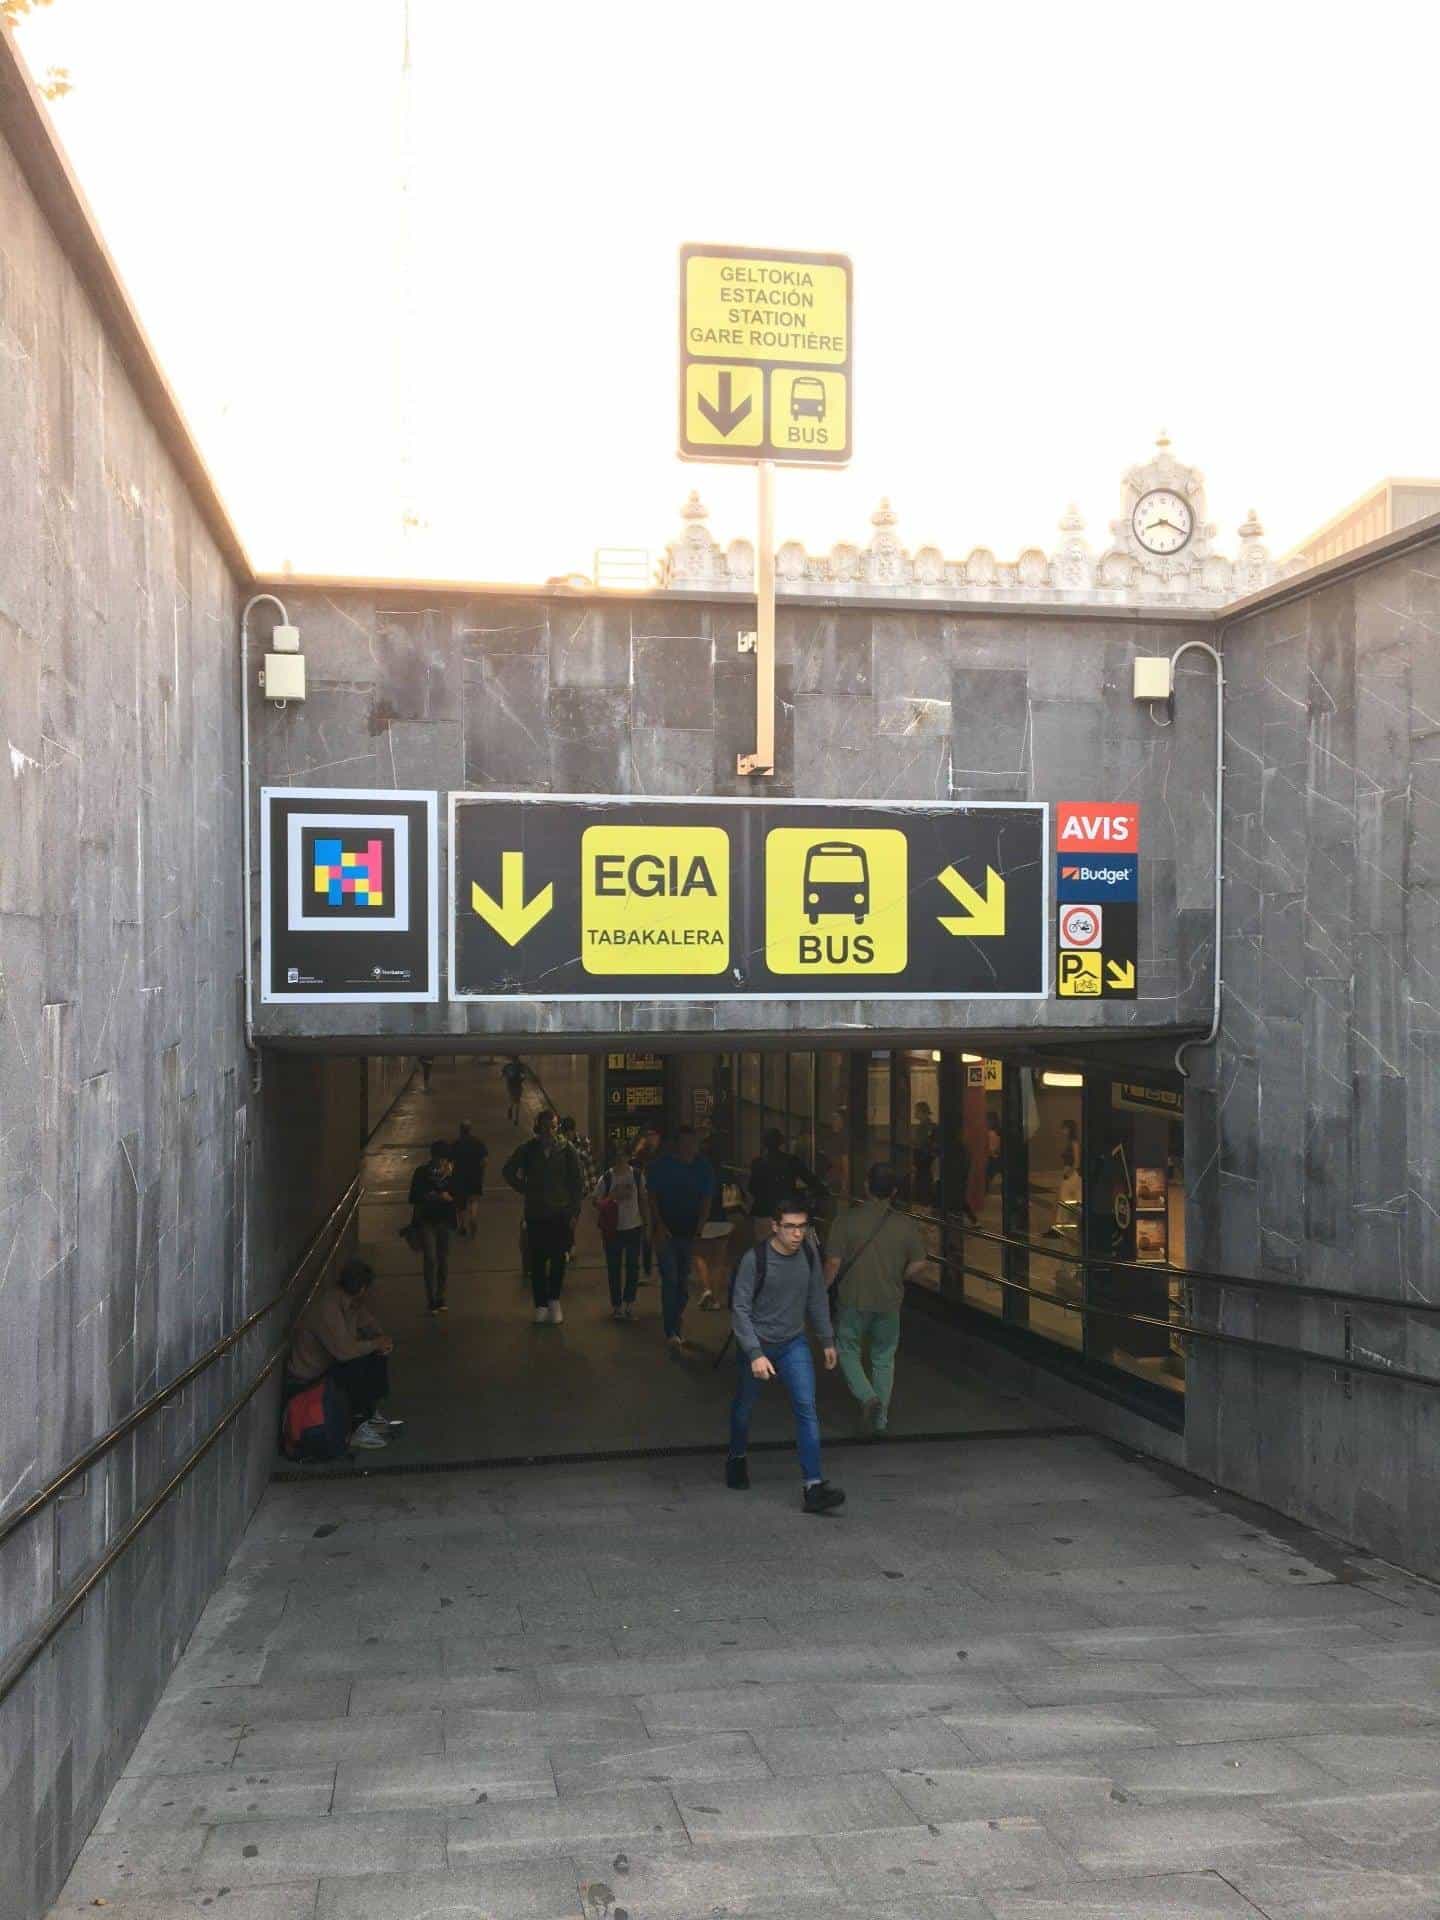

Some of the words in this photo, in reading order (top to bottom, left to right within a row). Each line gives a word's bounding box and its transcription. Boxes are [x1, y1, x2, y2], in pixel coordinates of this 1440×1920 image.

[720, 267, 813, 287] GELTOKIA
[720, 287, 813, 307] ESTACIÓN
[728, 309, 806, 328] STATION
[690, 327, 744, 344] GARE
[788, 427, 828, 444] BUS
[1061, 815, 1129, 841] AVIS
[595, 855, 718, 897] EGIA
[1080, 867, 1130, 884] Budget
[587, 929, 724, 945] TABAKALERA
[799, 935, 875, 965] BUS
[1062, 954, 1083, 983] P
